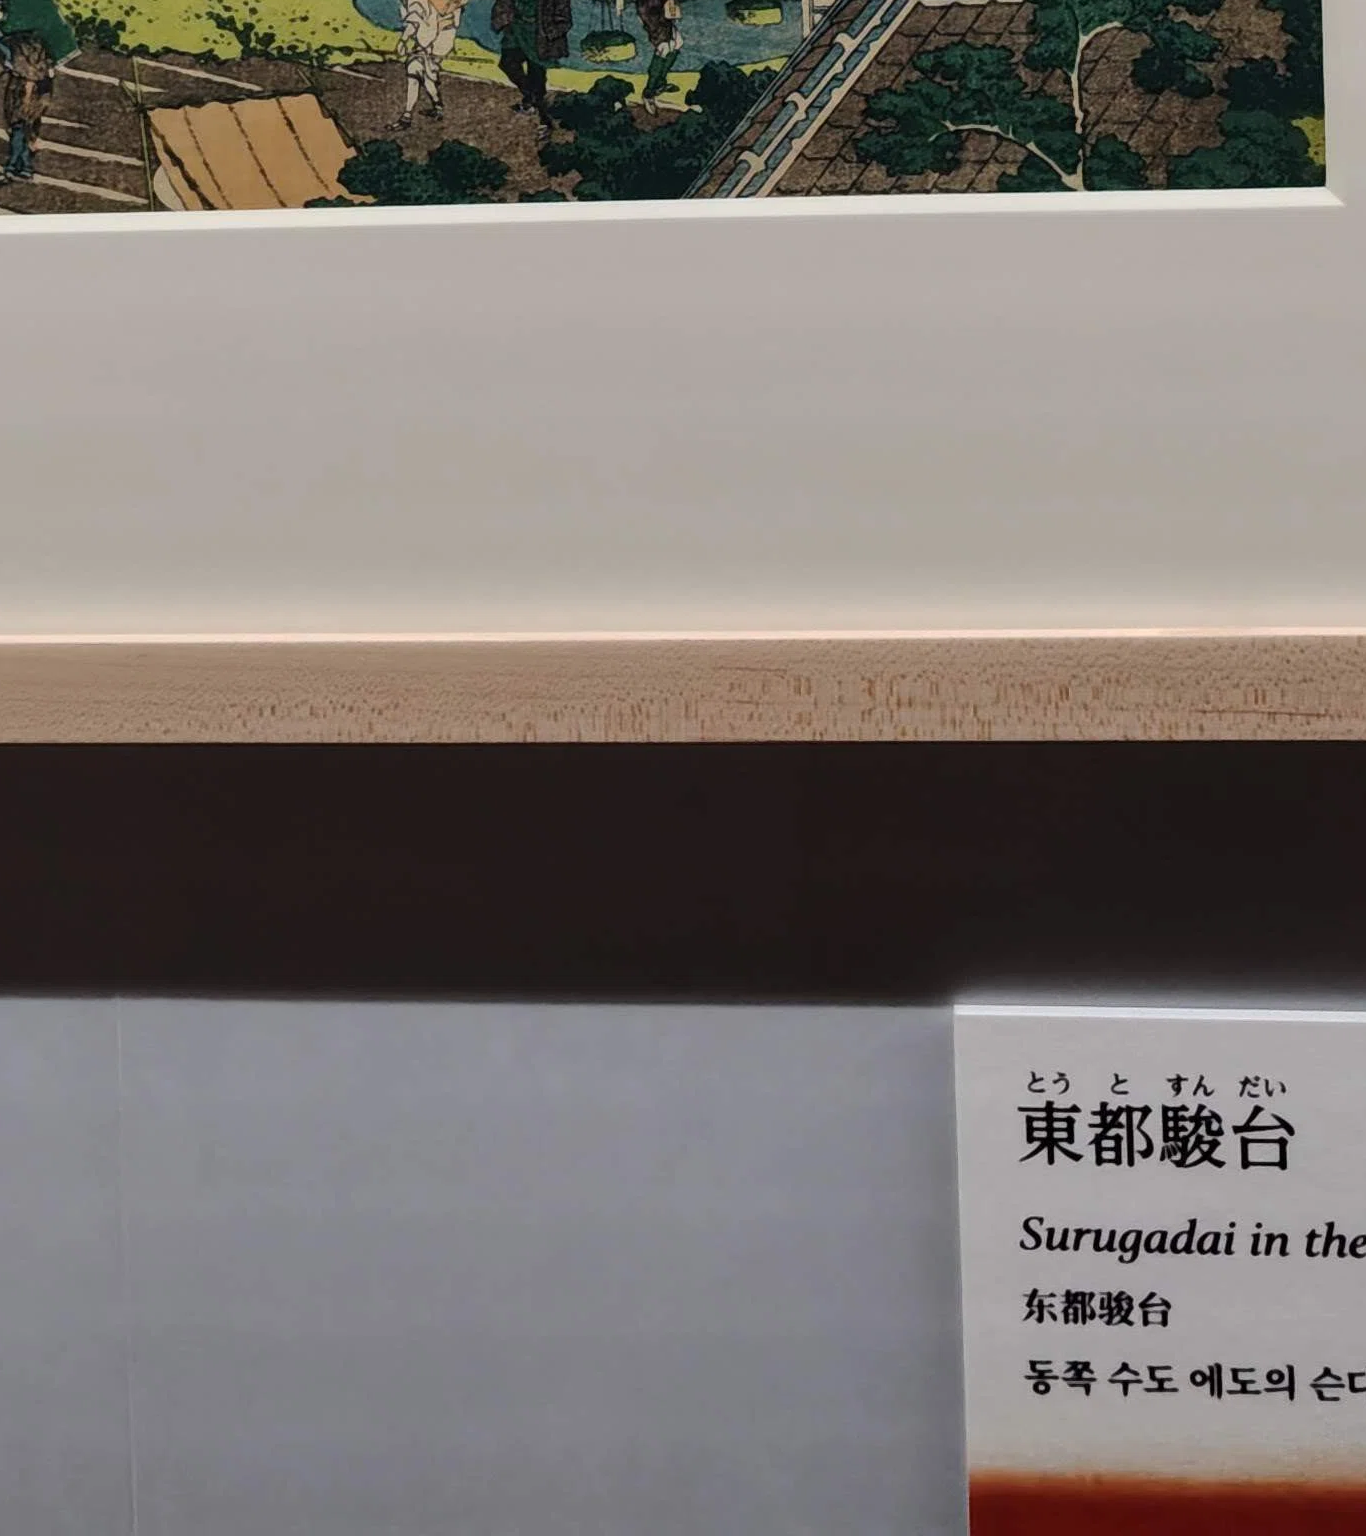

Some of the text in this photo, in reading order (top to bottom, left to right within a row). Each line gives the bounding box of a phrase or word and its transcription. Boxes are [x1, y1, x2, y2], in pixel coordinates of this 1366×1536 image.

[1026, 1071, 1287, 1099] とう と すん だい
[1018, 1101, 1295, 1171] 東都駿台
[1020, 1216, 1237, 1265] Surugadai
[1250, 1222, 1290, 1258] in
[1022, 1287, 1172, 1328] 东都骏台
[1023, 1359, 1098, 1397] 동쪽
[1107, 1361, 1180, 1398] 수도
[1189, 1362, 1296, 1402] 에도의
